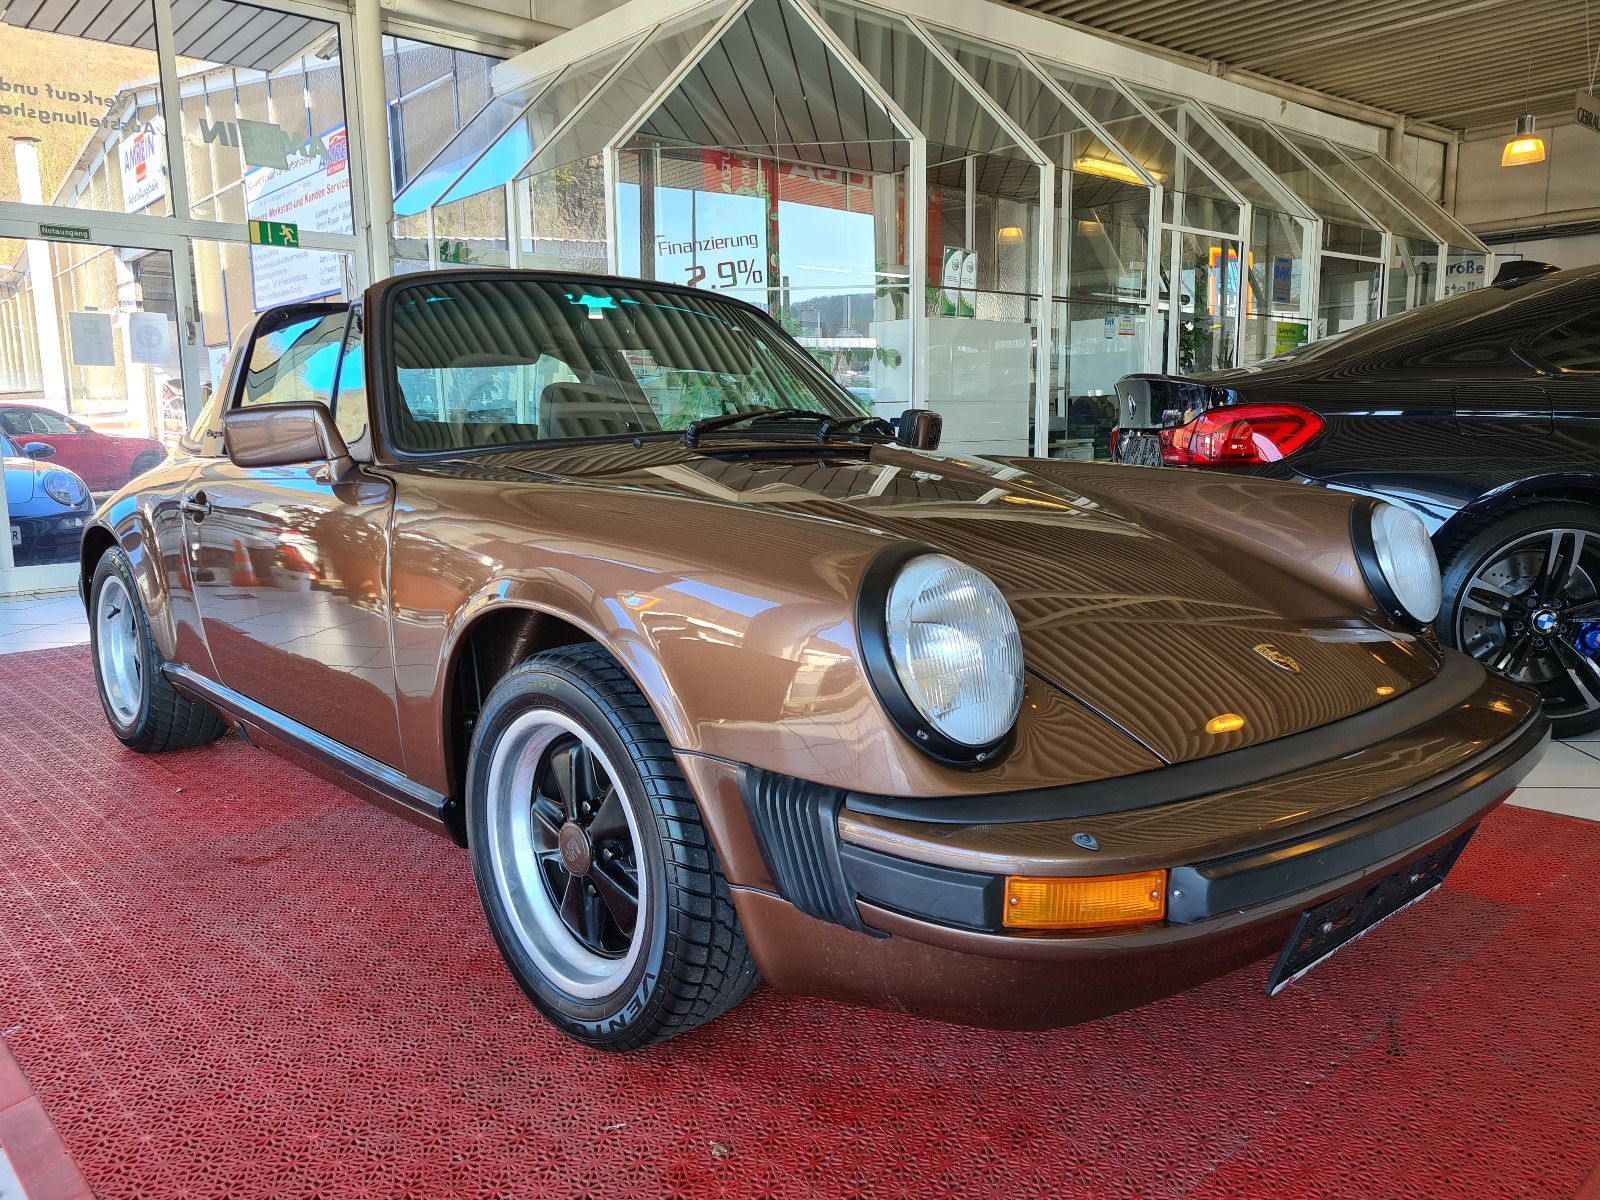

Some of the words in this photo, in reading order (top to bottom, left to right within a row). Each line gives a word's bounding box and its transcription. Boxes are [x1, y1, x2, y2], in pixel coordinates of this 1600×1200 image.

[125, 133, 155, 173] AMREIN
[41, 227, 88, 239] Notausgang
[657, 234, 759, 257] Finanzierung
[684, 258, 763, 290] 2.9%
